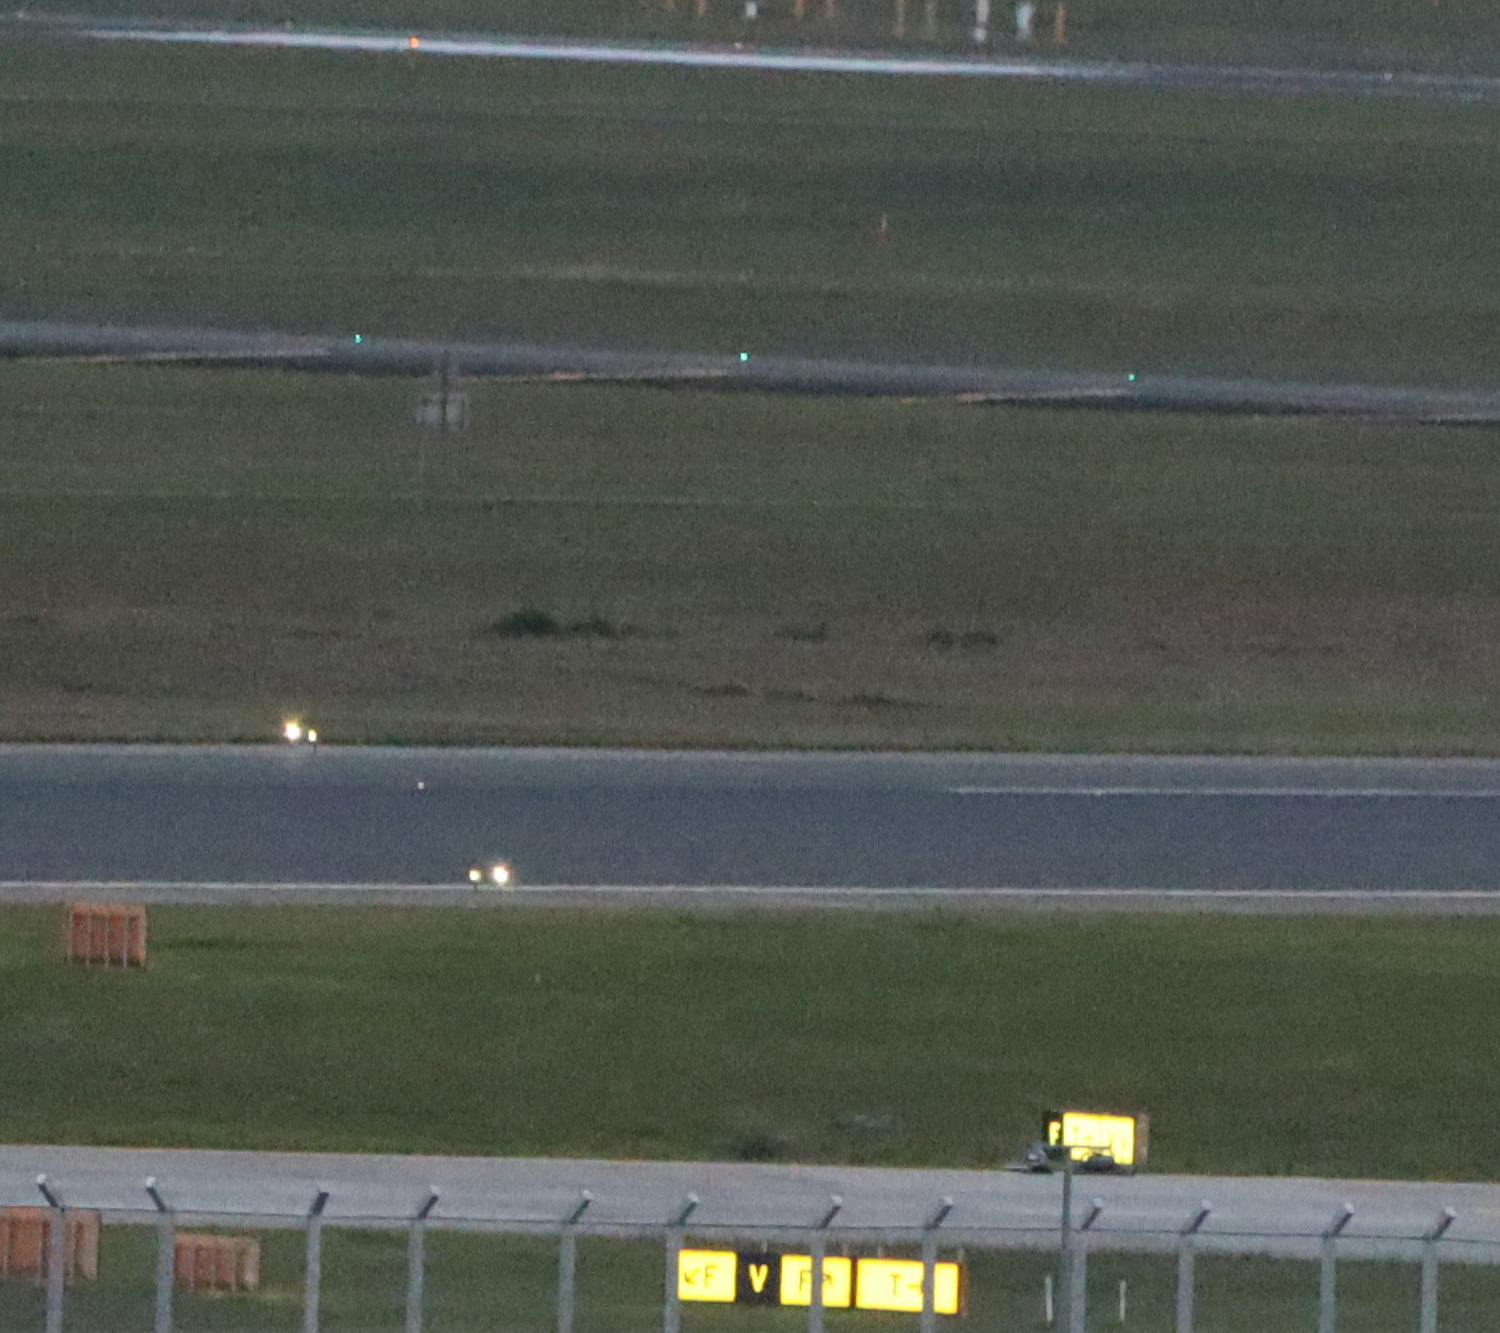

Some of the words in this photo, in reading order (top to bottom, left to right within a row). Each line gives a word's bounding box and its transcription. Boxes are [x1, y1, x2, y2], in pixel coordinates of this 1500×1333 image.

[703, 1263, 719, 1288] F
[749, 1263, 768, 1293] V
[890, 1273, 902, 1297] T
